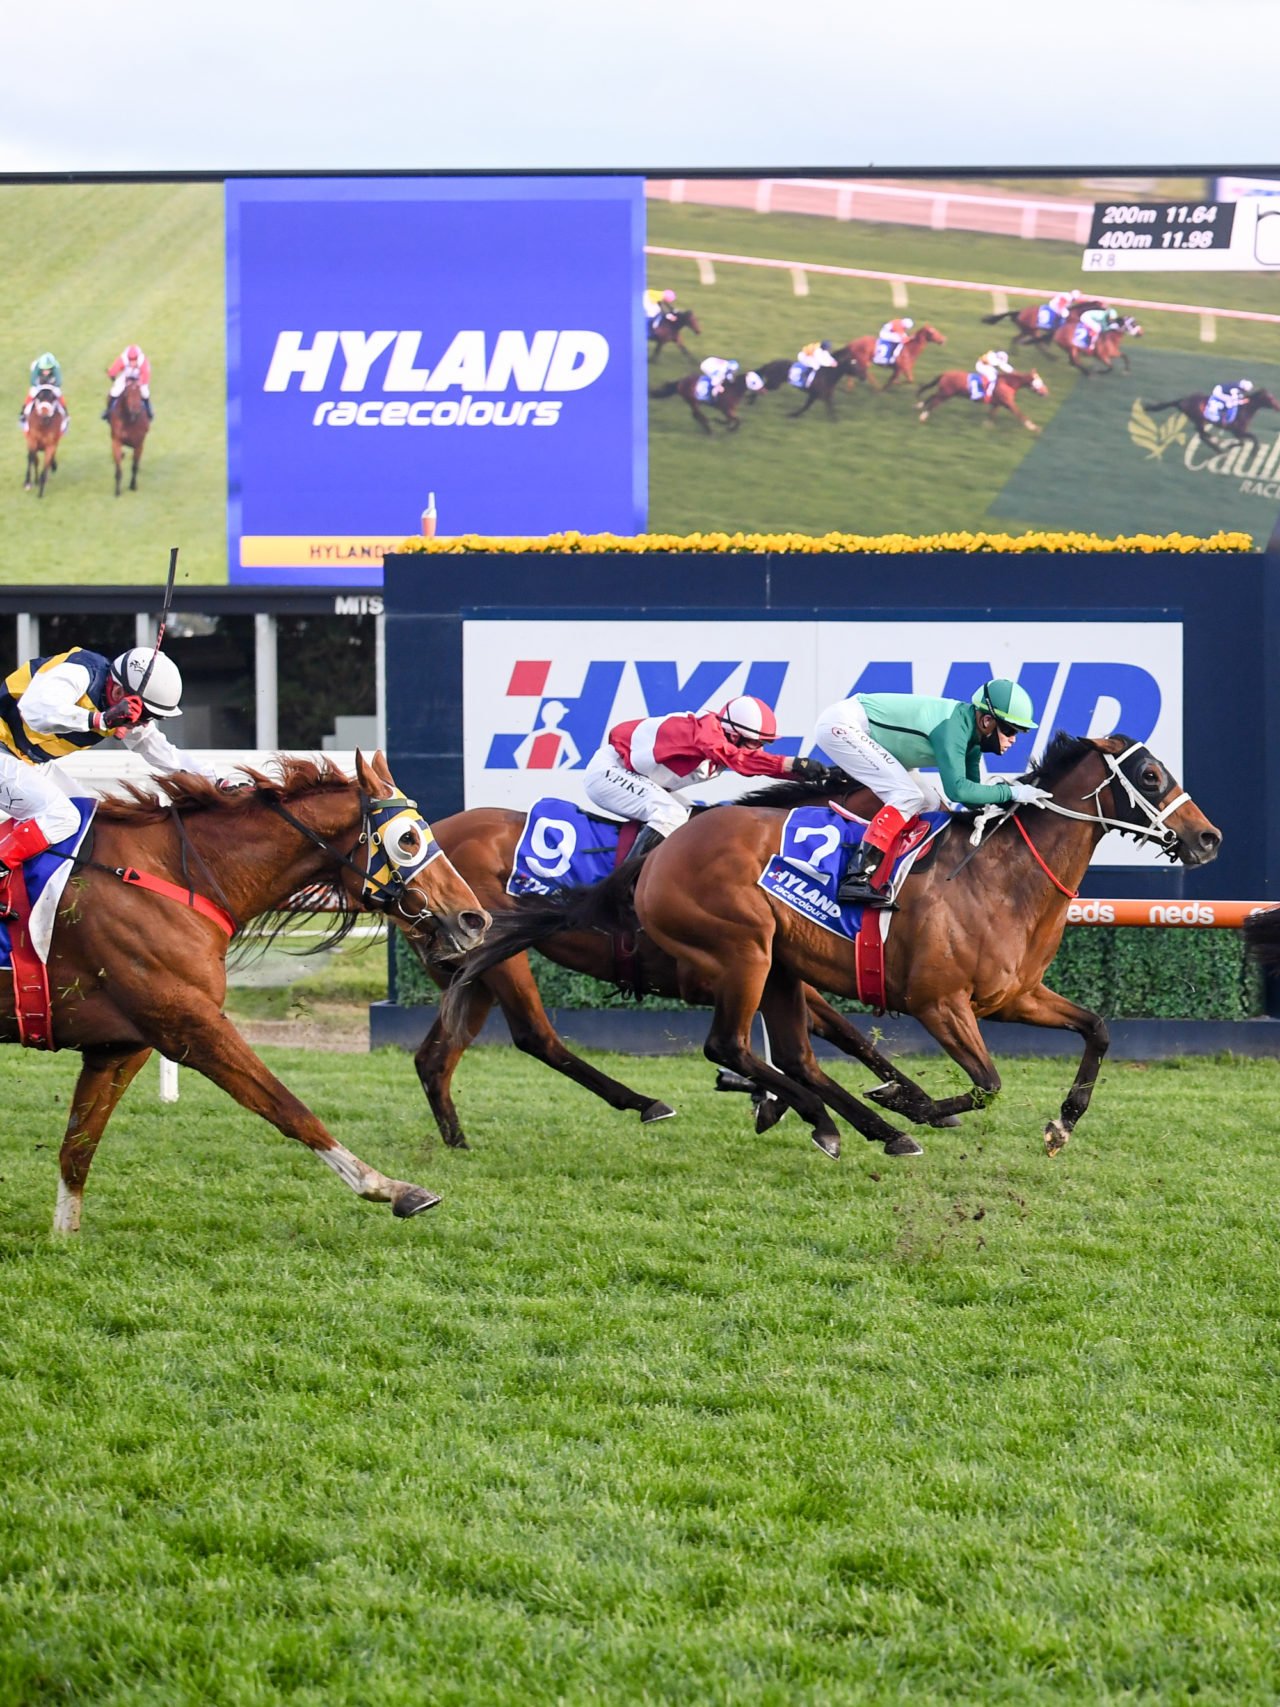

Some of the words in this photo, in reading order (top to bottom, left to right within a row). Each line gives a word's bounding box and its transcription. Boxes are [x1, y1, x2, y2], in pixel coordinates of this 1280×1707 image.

[1102, 206, 1157, 223] 200m
[1166, 206, 1218, 223] 11.64
[1098, 231, 1152, 248] 400m
[1161, 230, 1213, 248] 11.98
[1090, 253, 1102, 267] R
[263, 331, 610, 392] HYLAND
[313, 395, 562, 426] racecolours
[605, 769, 646, 798] V.PIKE
[525, 817, 576, 878] 9
[785, 825, 841, 886] 2
[768, 867, 841, 918] HYLAND
[772, 884, 828, 921] racecolours
[1066, 901, 1114, 922] eds
[1150, 902, 1214, 924] neds
